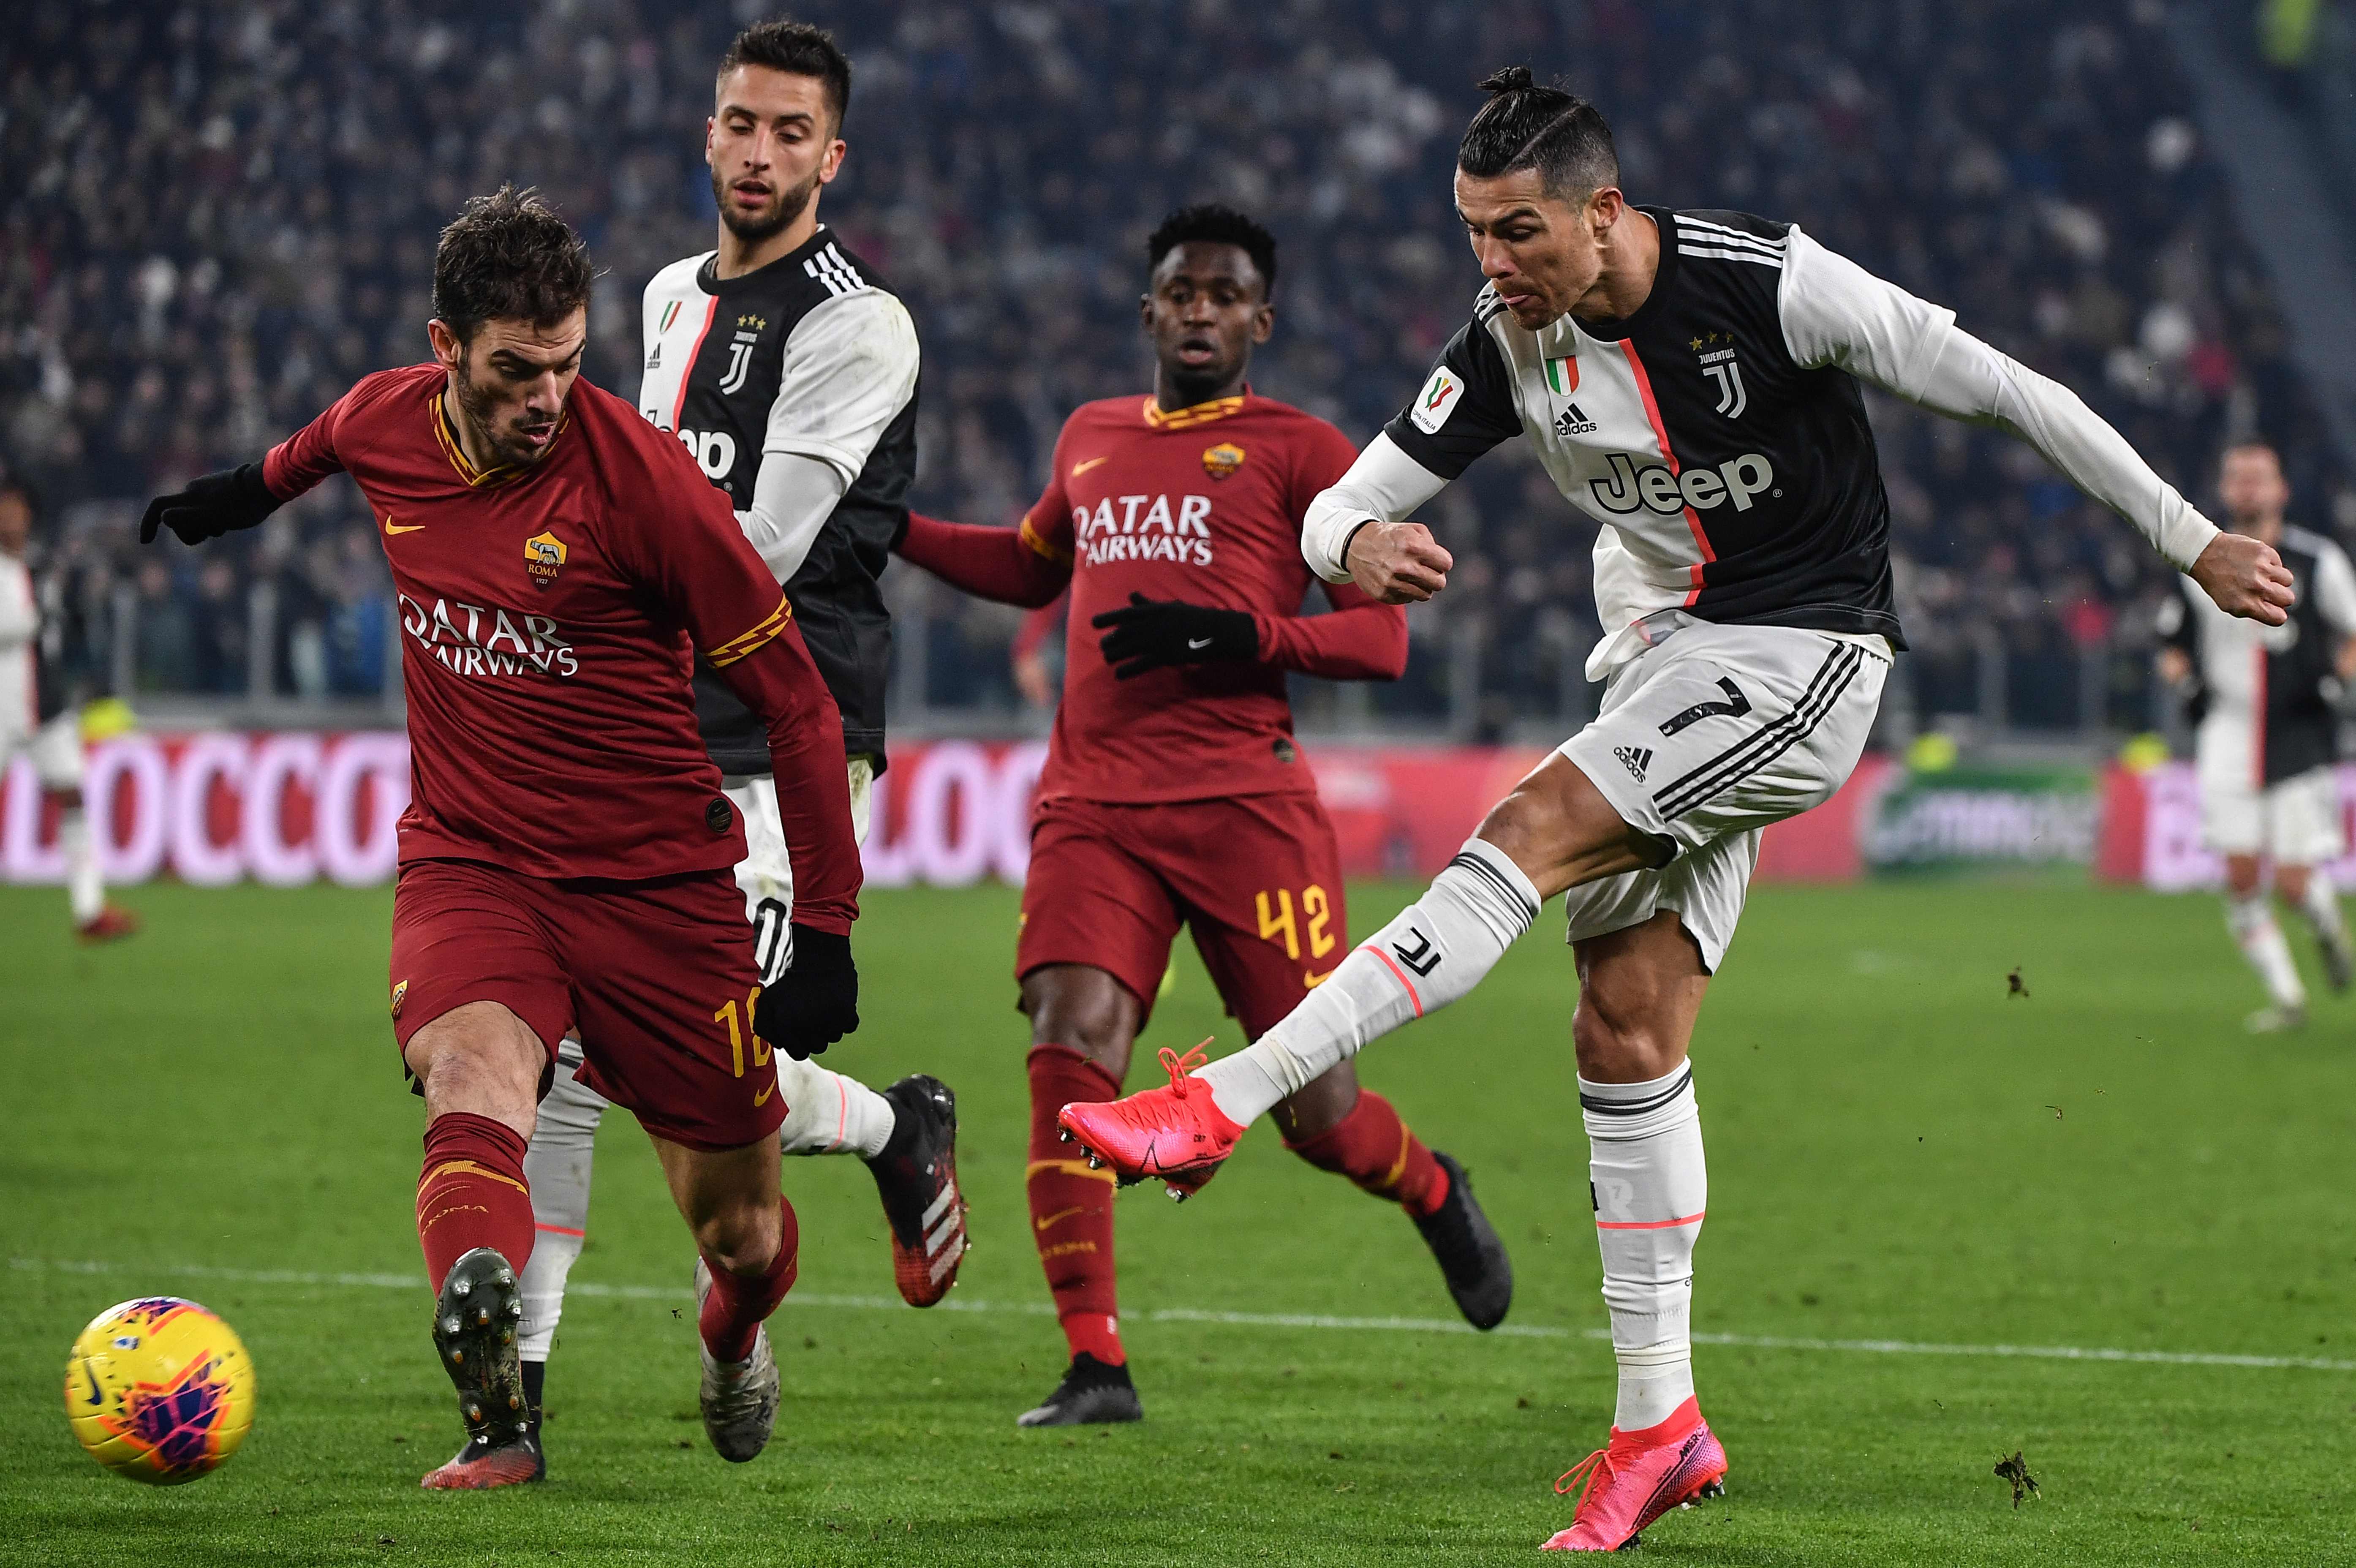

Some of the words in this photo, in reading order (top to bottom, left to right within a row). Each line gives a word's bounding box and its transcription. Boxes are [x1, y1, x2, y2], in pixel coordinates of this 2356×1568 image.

[1698, 348, 1735, 365] JUVENTUS
[1421, 417, 1436, 430] ITALIA
[1588, 452, 1773, 516] Jeep
[1073, 494, 1212, 550] QATAR
[1085, 534, 1213, 568] AIRWAYS
[528, 564, 558, 577] ROMA
[399, 593, 571, 653] QATAR
[436, 645, 579, 676] AIRWAYS
[1657, 675, 1753, 738] 7
[1613, 746, 1646, 783] adidas
[1254, 884, 1336, 961] 42
